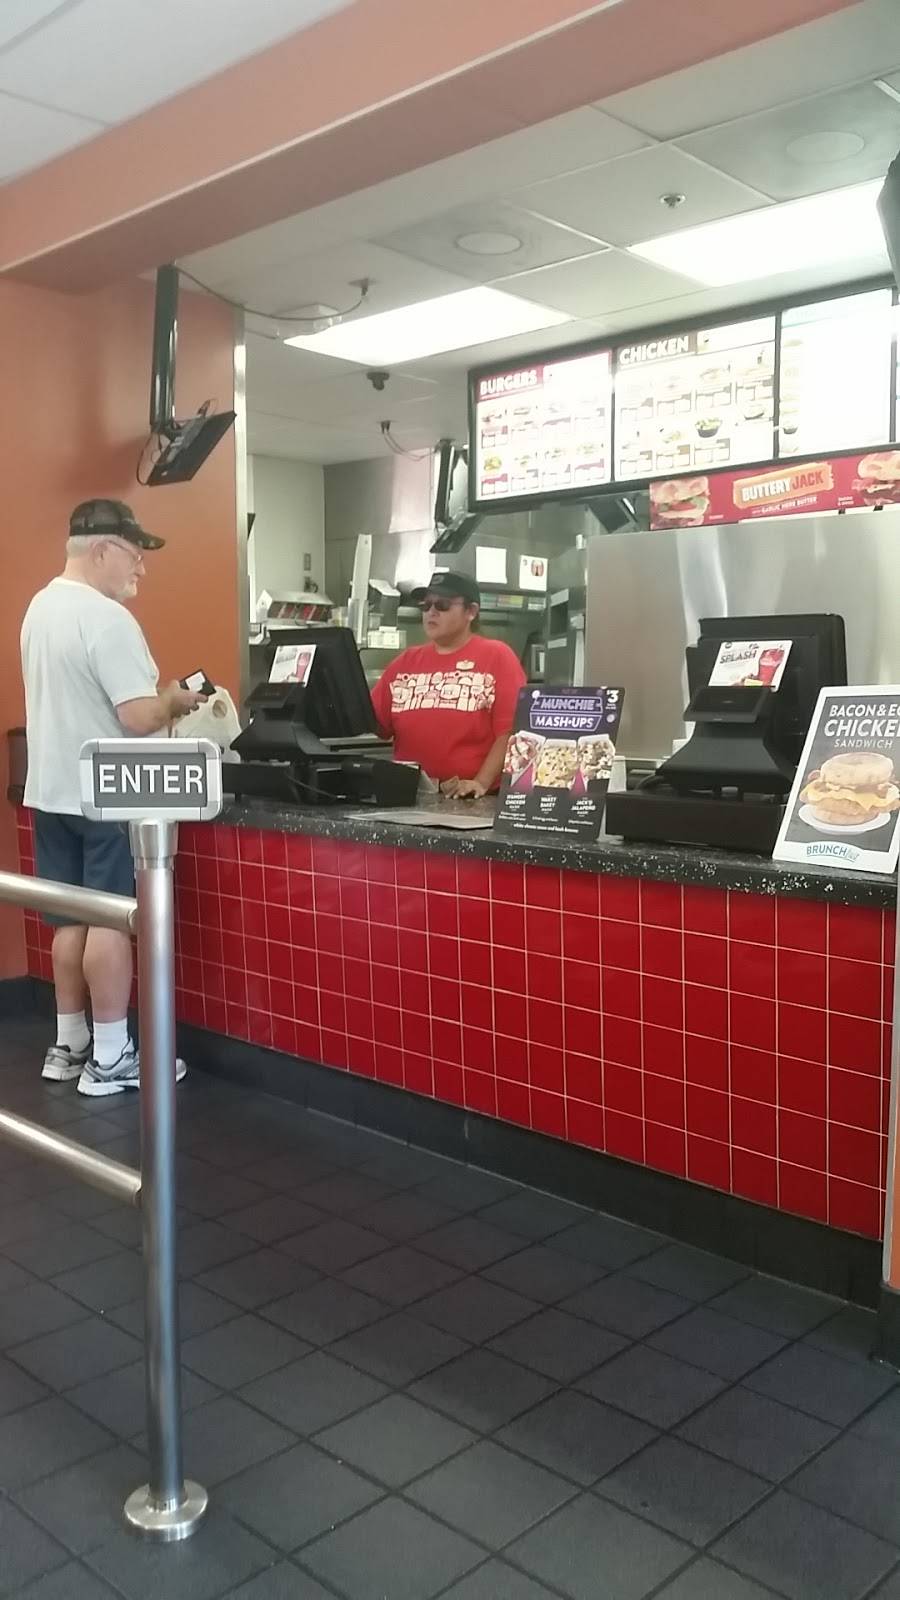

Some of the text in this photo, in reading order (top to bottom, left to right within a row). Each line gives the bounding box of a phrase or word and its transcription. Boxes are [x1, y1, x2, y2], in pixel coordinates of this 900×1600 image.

[619, 335, 690, 364] CHICKEN
[480, 369, 538, 395] BURGERS
[720, 649, 757, 664] SPLASH
[540, 698, 595, 710] MUNCHIE
[834, 739, 893, 749] SANDWICH
[99, 764, 203, 793] ENTER
